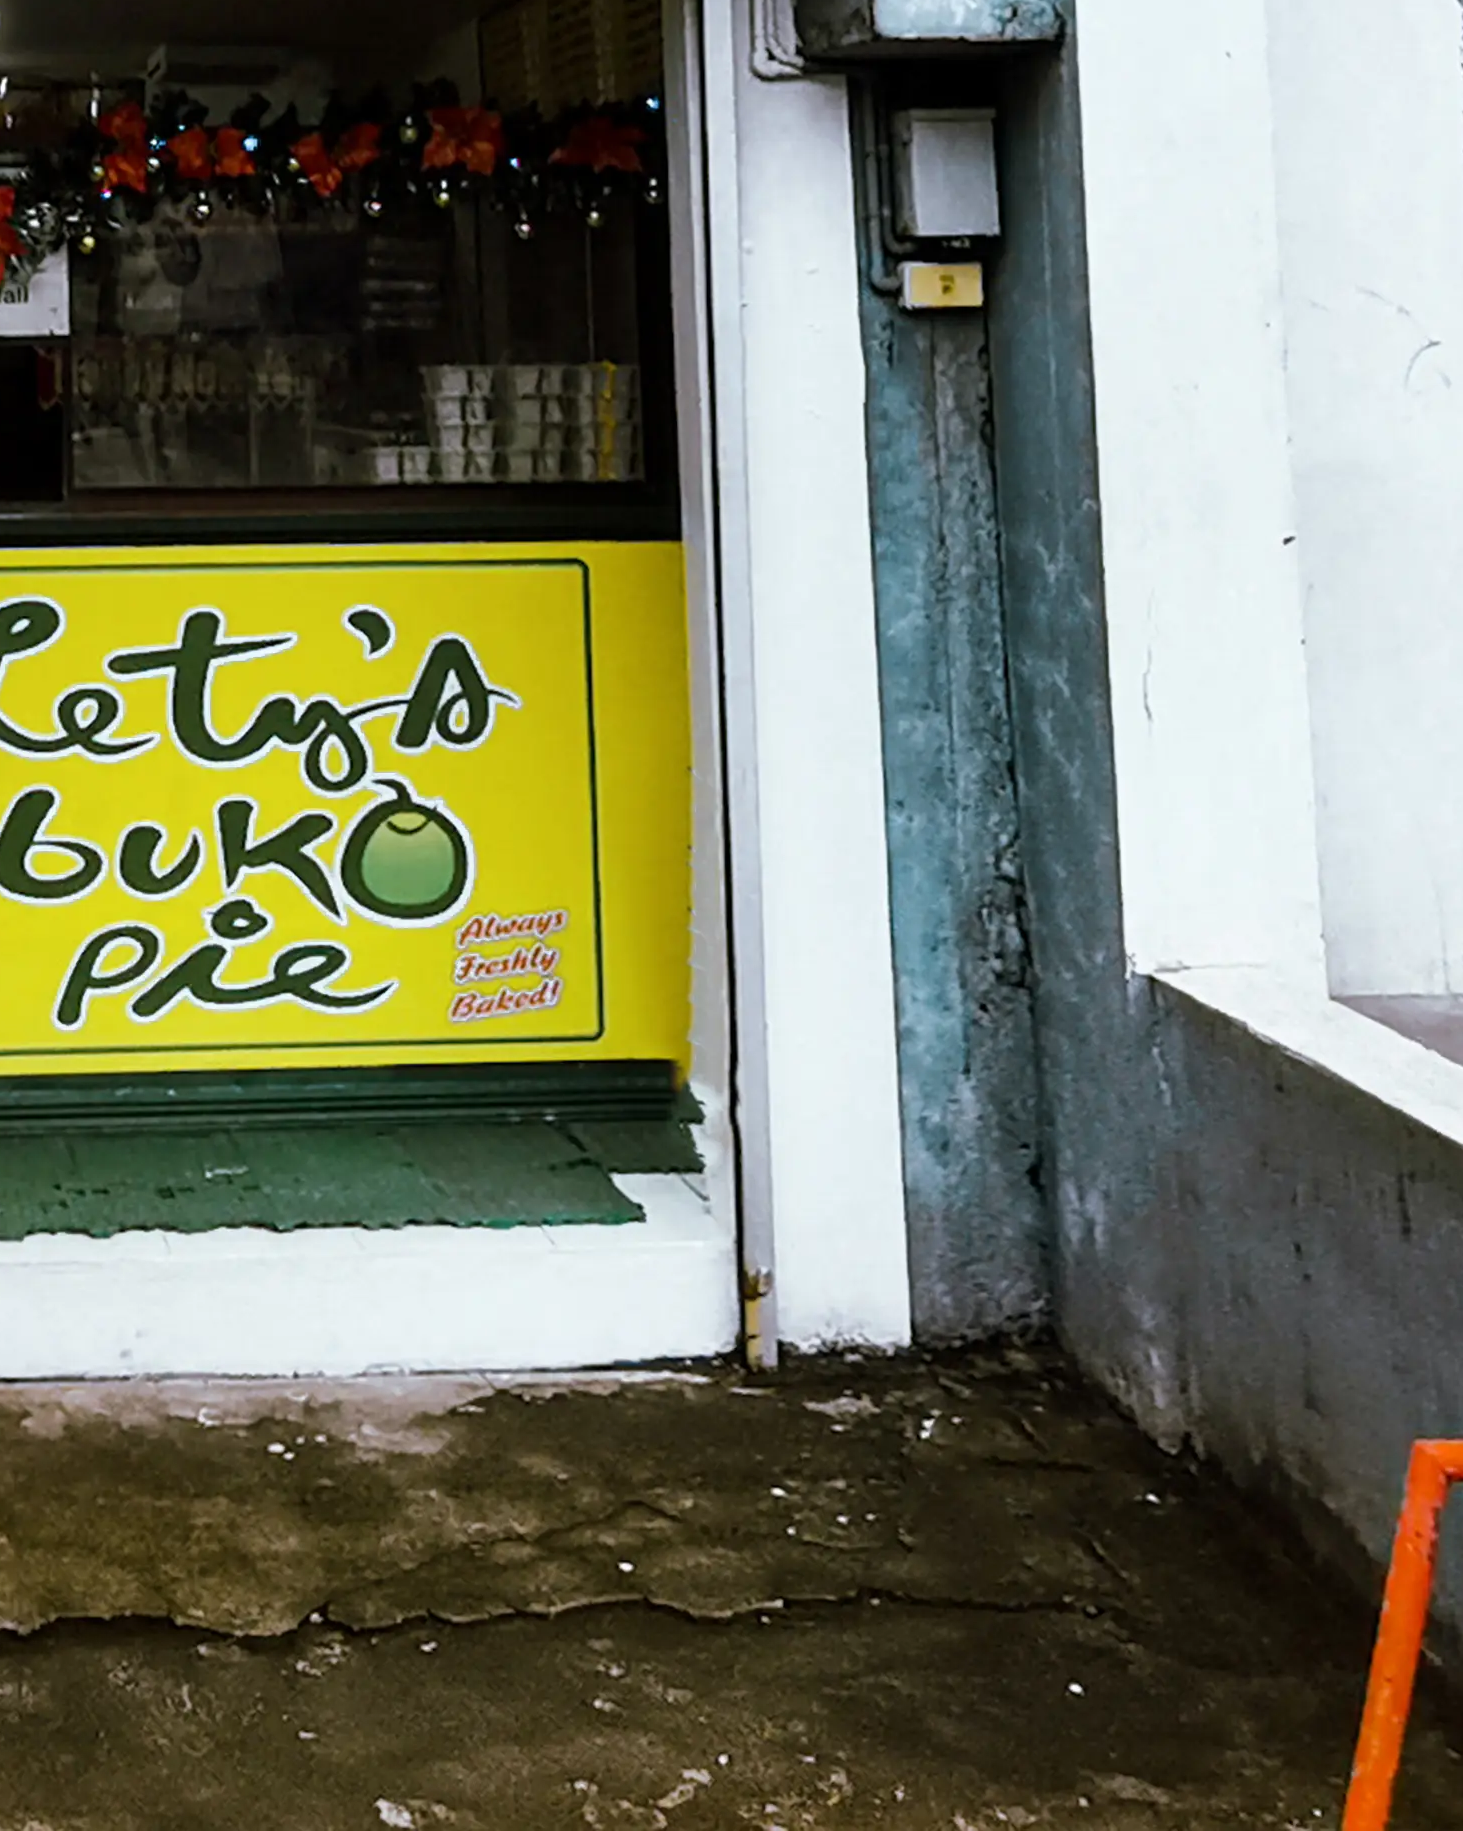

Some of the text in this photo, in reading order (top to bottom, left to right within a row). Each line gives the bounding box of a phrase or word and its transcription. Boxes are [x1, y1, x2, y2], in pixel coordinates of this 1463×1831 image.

[457, 910, 567, 947] Always
[455, 944, 559, 982] Freshly
[451, 979, 561, 1019] Baked!
